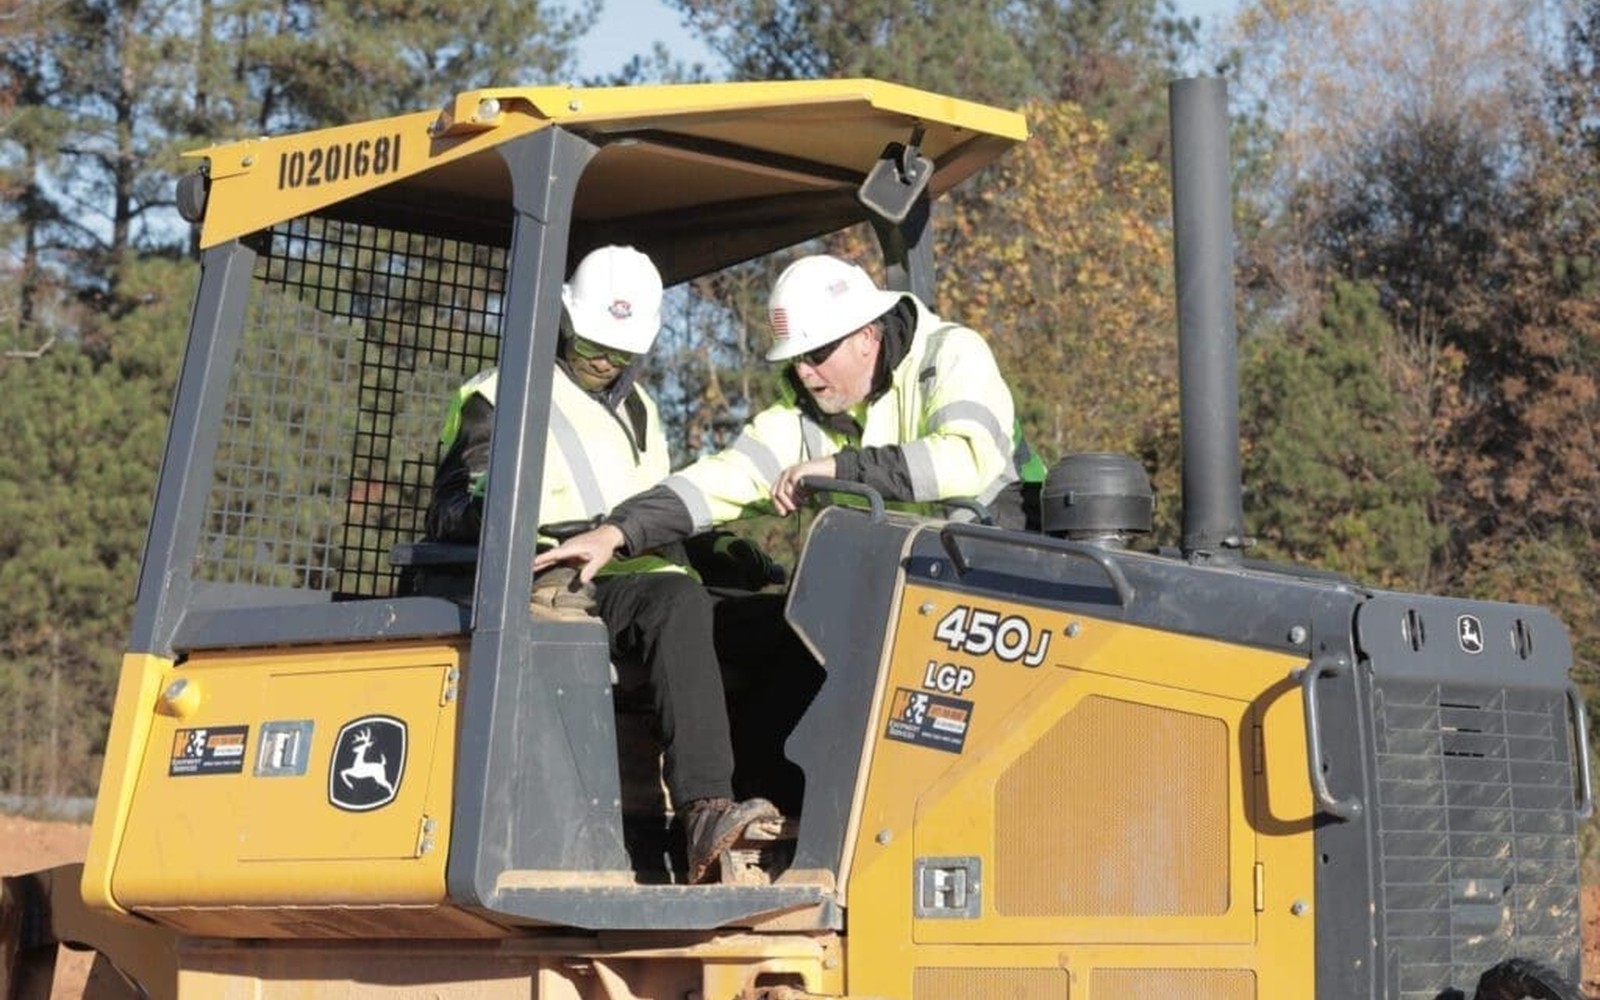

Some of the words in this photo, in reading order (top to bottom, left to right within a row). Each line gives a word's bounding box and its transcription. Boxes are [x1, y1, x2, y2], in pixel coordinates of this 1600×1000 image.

[278, 134, 401, 190] 10201681
[934, 605, 1052, 668] 450J
[923, 659, 975, 695] LGP
